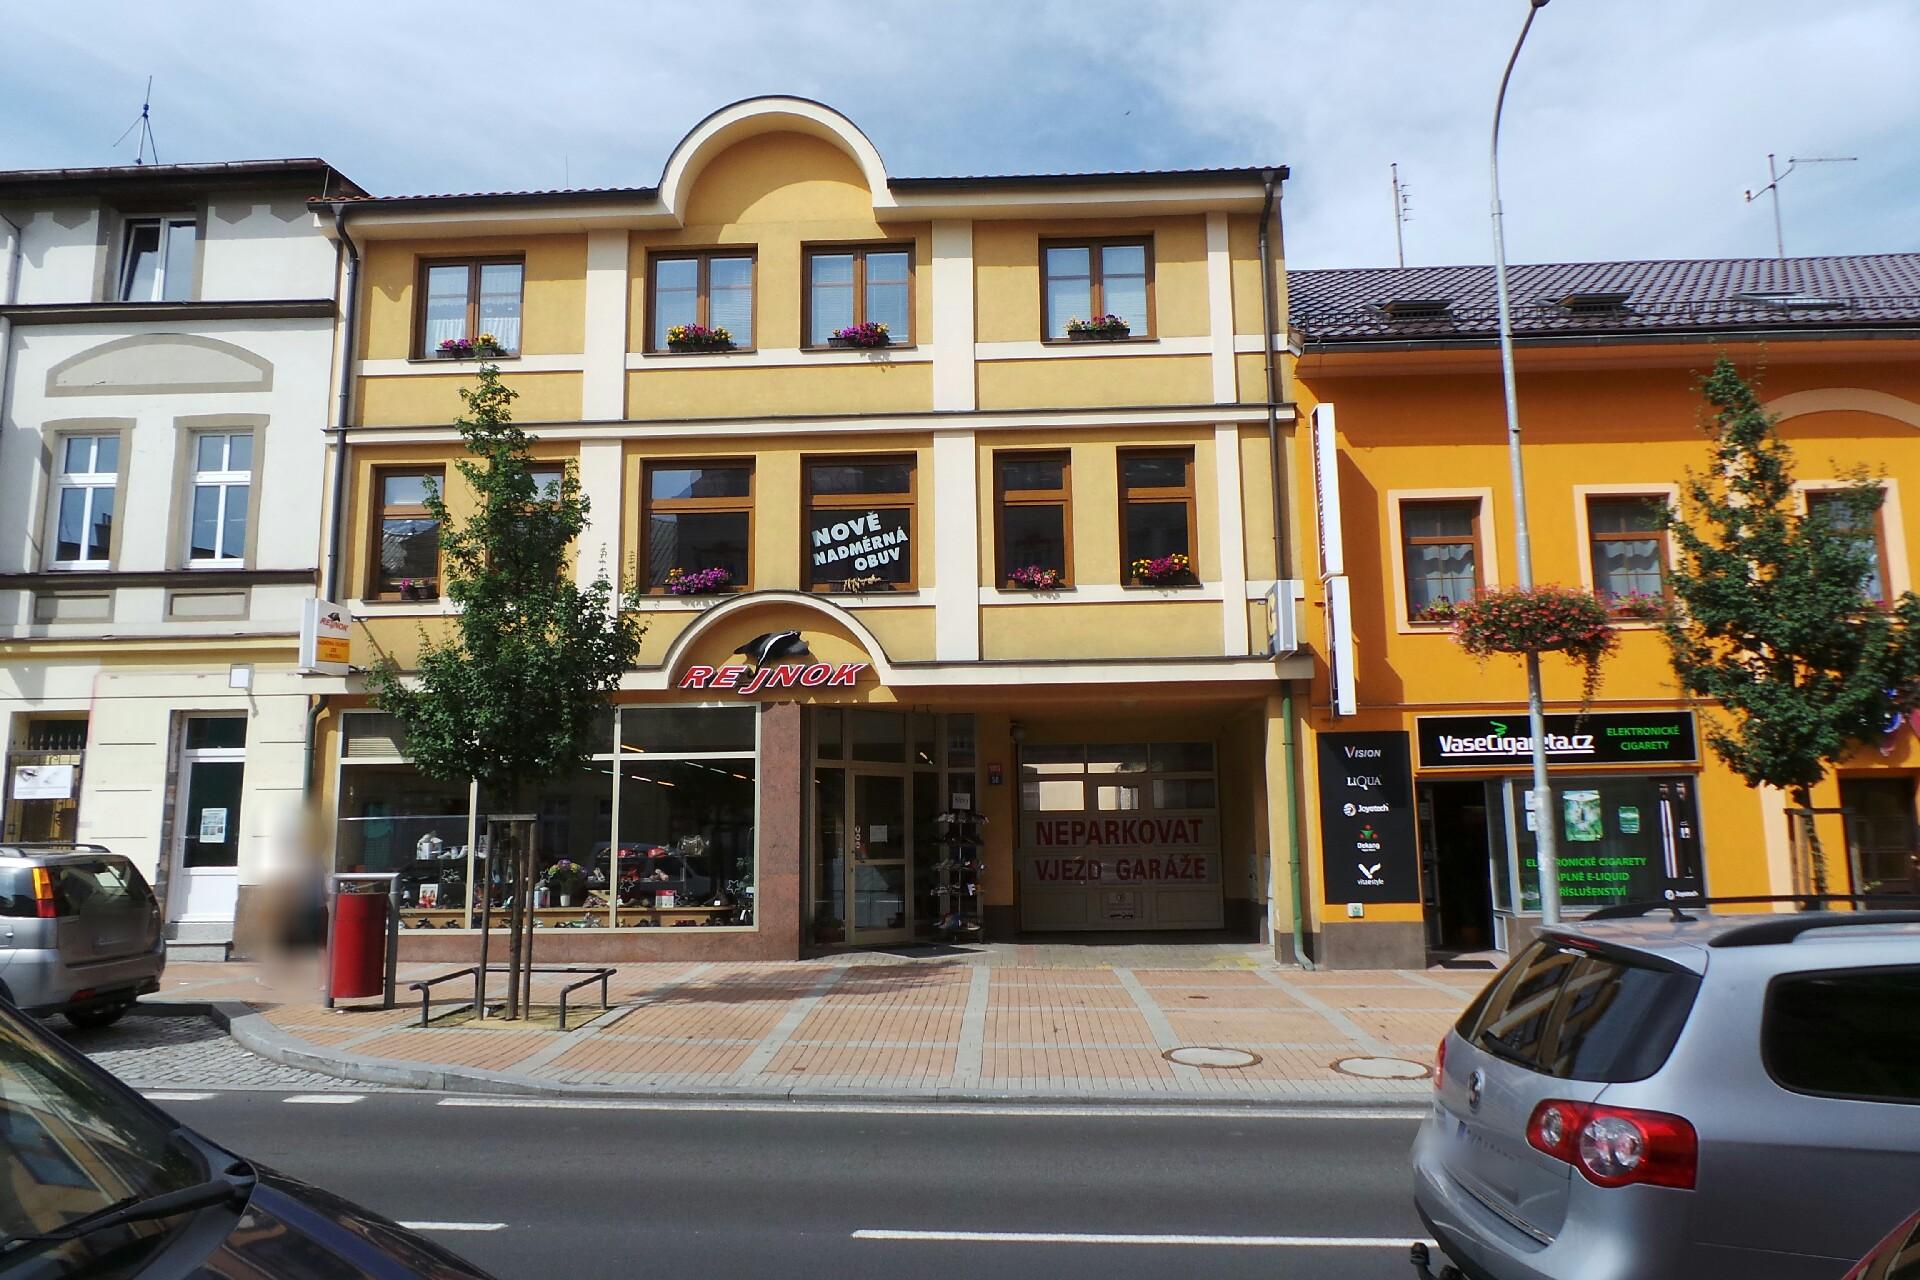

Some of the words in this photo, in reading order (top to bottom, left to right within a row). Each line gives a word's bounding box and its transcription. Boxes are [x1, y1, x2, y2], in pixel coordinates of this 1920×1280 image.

[813, 526, 908, 566] NADMĚRNÁ
[854, 547, 900, 571] OBUV
[678, 663, 868, 694] REJNOK
[1620, 741, 1669, 750] CIGARETY
[1035, 819, 1203, 846] NEPARKOVAT
[1034, 859, 1102, 881] VJEZD
[1116, 854, 1207, 881] GARÁŽE
[1599, 857, 1648, 866] CIGARETY
[1586, 872, 1631, 881] E-LIQUID
